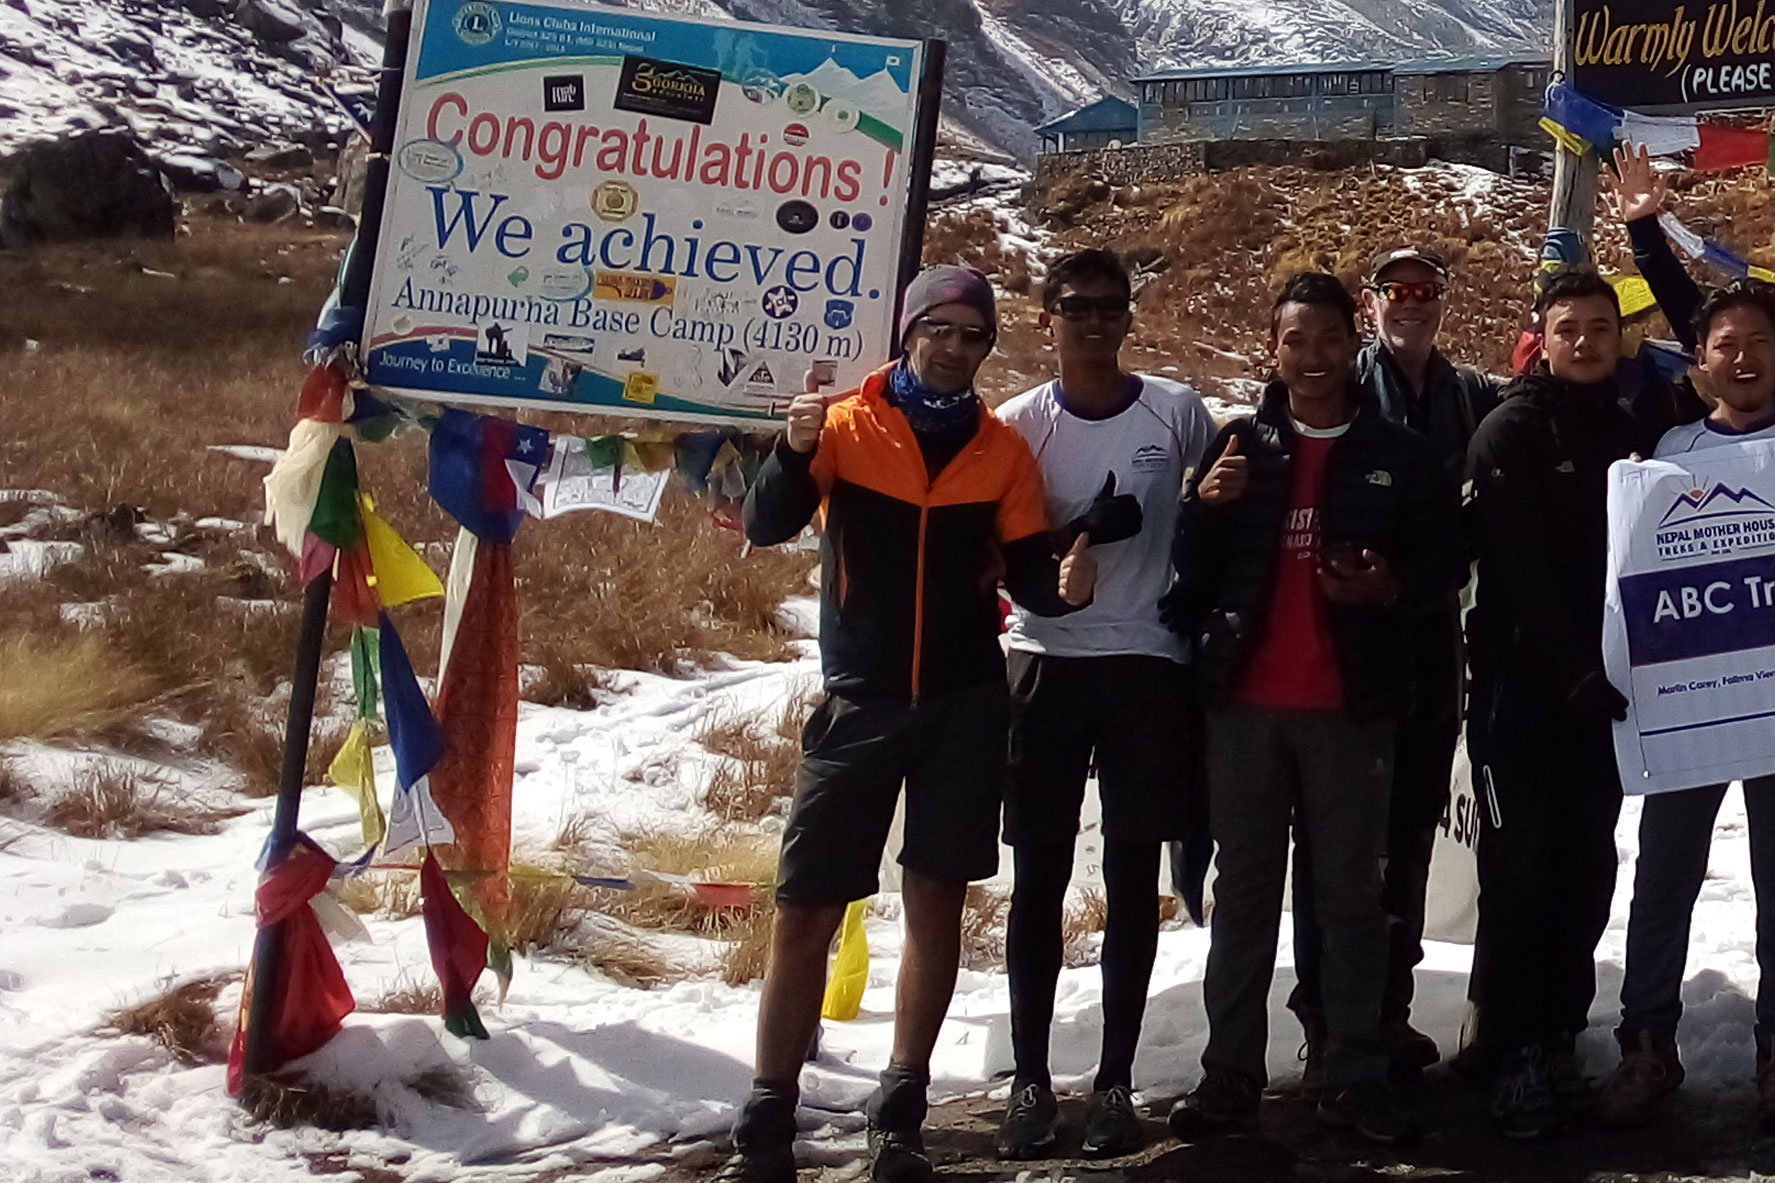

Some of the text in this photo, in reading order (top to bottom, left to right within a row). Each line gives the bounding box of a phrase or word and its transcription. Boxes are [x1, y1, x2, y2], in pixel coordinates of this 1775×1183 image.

[509, 10, 541, 28] Lions
[543, 17, 578, 32] Clubs
[580, 20, 657, 43] International
[1574, 5, 1697, 79] Warmly
[1680, 63, 1772, 104] (PLEASE
[426, 92, 862, 203] Congratulations
[425, 184, 880, 300] We achieved.
[391, 276, 559, 325] Annapurna
[568, 297, 640, 334] Base
[650, 305, 734, 352] Camp
[743, 318, 819, 354] (4130
[826, 329, 864, 362] m)
[379, 351, 426, 373] Journey
[431, 356, 444, 372] to
[1656, 532, 1692, 546] NEPAL
[1694, 523, 1741, 539] MOTHER
[1658, 543, 1694, 556] TREKS
[1653, 581, 1735, 624] ABC
